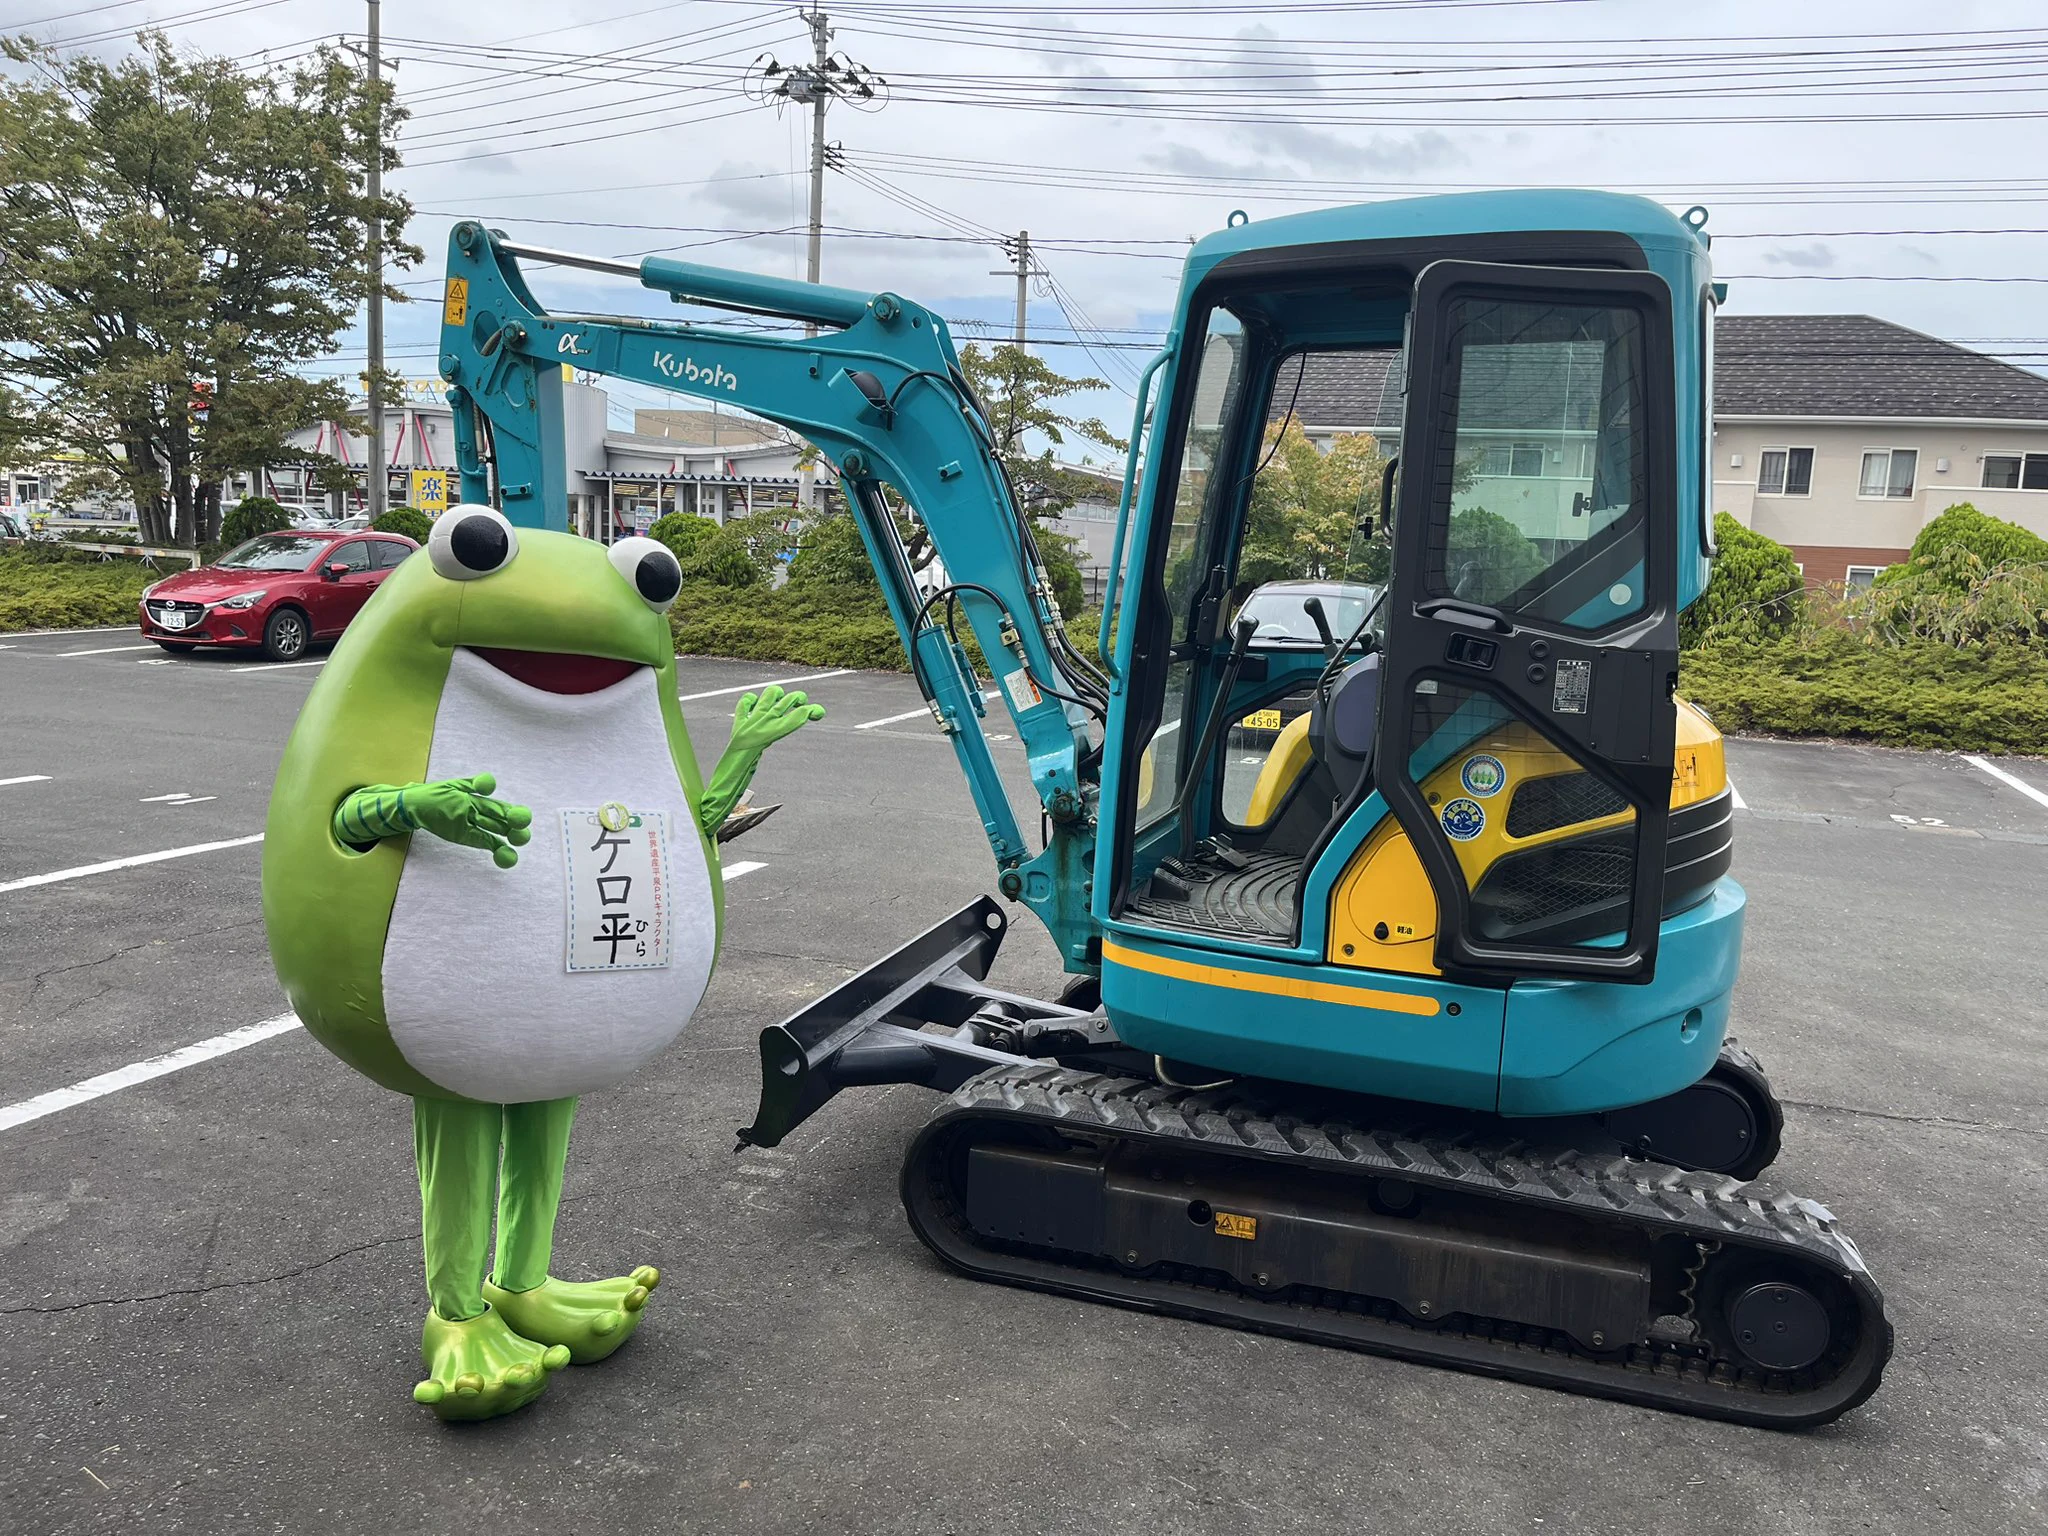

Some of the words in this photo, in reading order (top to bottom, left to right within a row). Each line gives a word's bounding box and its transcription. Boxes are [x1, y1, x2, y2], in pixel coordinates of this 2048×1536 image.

[653, 351, 737, 391] Kubota
[1250, 717, 1278, 728] 45-05
[1889, 814, 1950, 827] 52
[590, 826, 637, 965] ケロ平
[635, 919, 649, 957] ひら
